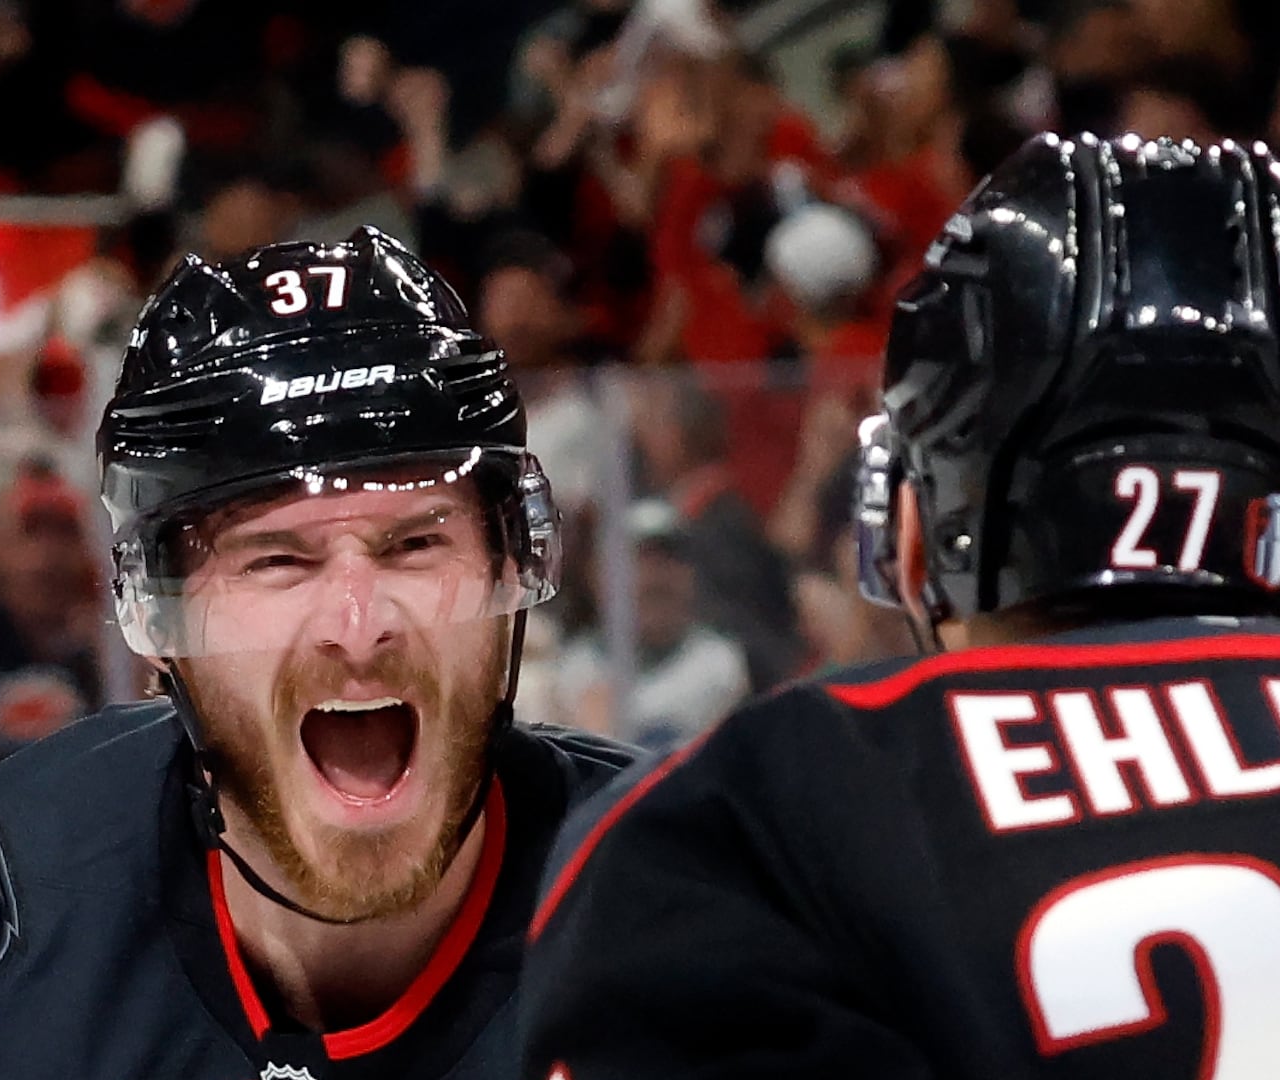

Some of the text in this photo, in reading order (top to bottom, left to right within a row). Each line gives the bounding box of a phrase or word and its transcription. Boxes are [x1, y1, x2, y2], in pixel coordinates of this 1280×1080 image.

[263, 264, 350, 316] 37
[260, 365, 395, 405] BAUER
[1111, 465, 1222, 571] 27
